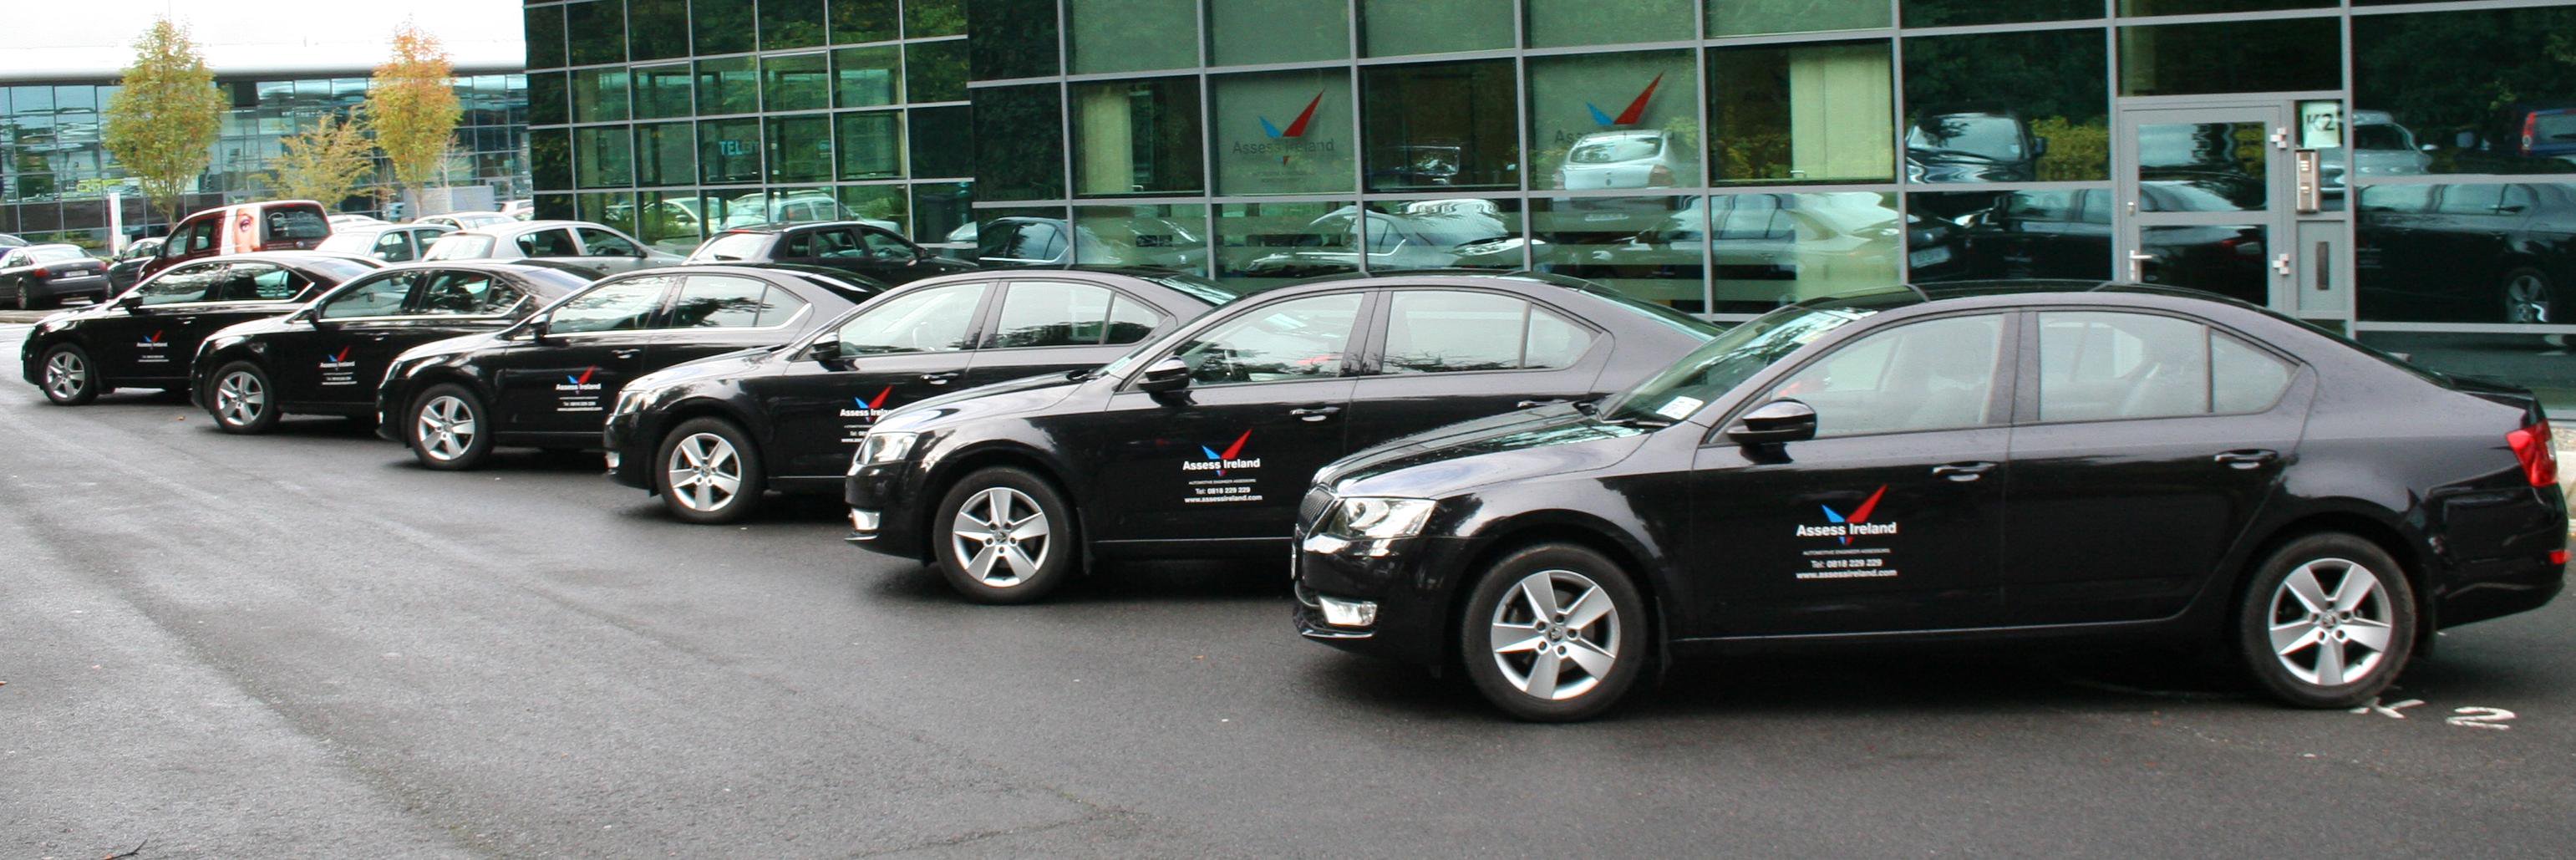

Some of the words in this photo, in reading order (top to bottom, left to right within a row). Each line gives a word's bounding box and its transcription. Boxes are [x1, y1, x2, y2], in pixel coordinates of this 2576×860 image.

[1232, 140, 1280, 154] Assess
[840, 409, 869, 417] Assess
[1182, 461, 1222, 471] Assess
[1223, 458, 1261, 469] Ireland
[1796, 524, 1846, 537] Assess
[1849, 522, 1898, 535] Ireland
